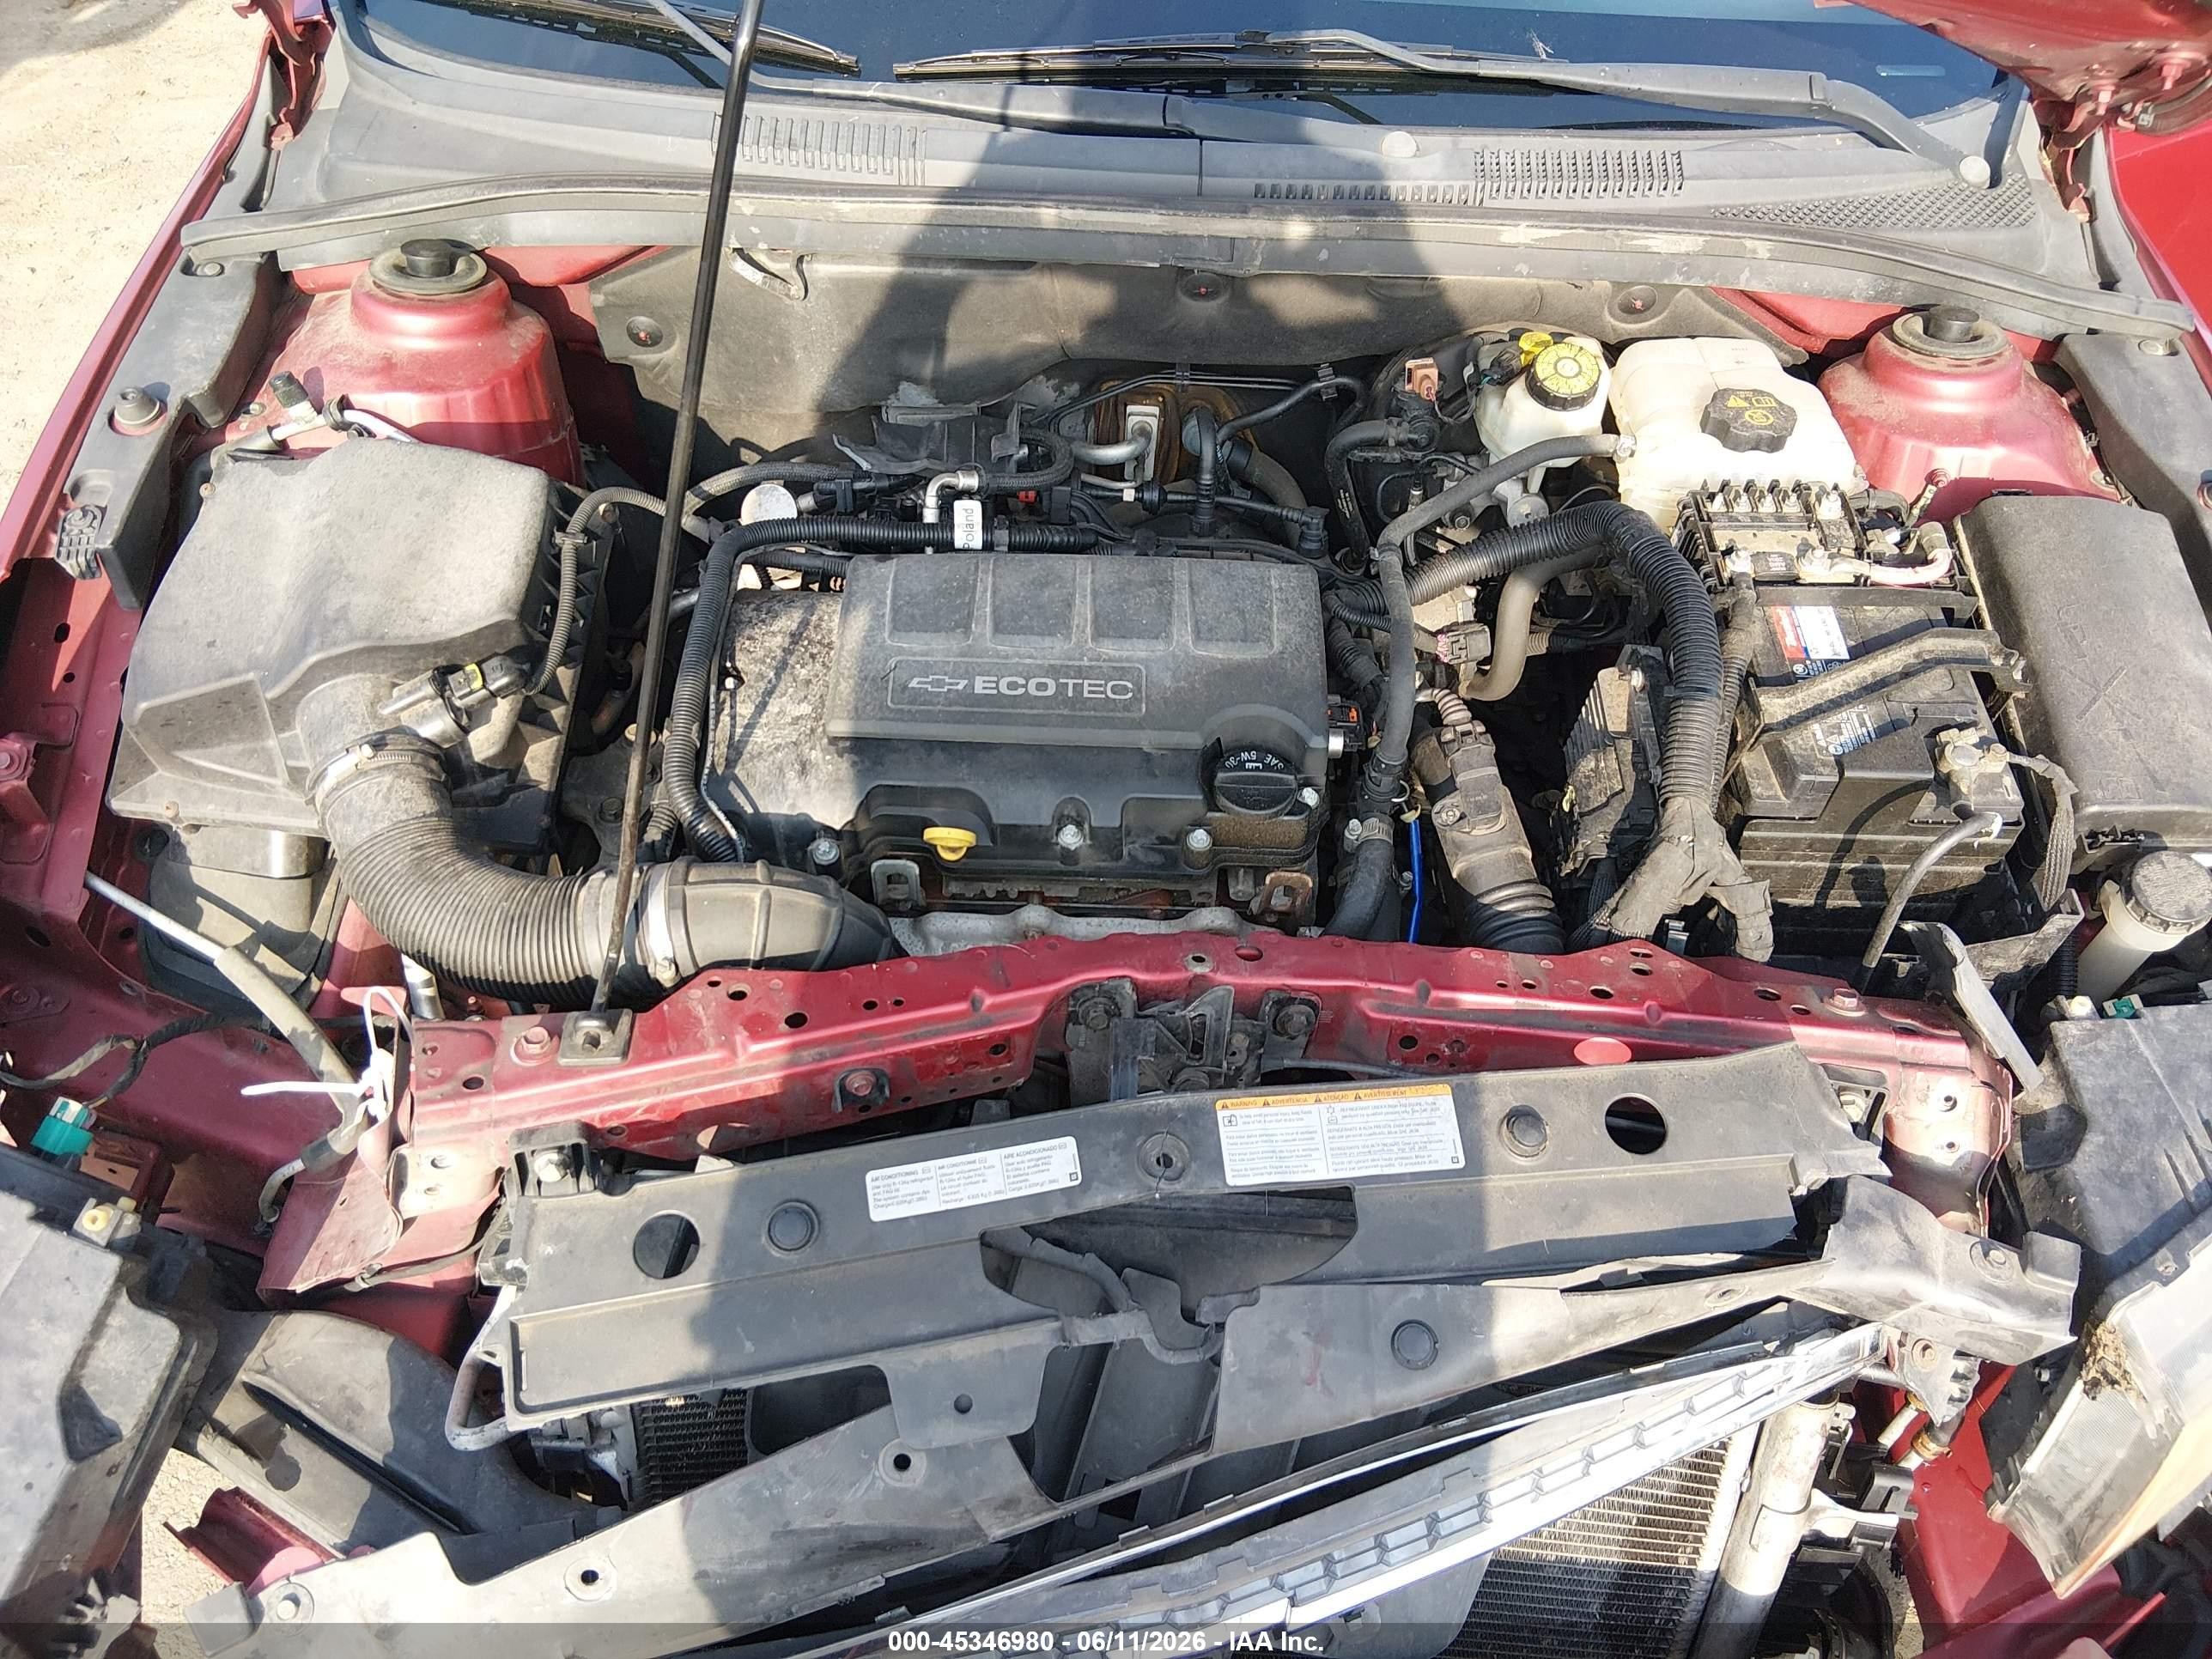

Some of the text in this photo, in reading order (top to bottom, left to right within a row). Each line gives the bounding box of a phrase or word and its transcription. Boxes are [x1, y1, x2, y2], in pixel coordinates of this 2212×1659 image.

[962, 507, 975, 550] Poland
[974, 676, 1133, 700] ECOTEC
[1224, 750, 1285, 771] SAE 5W-30
